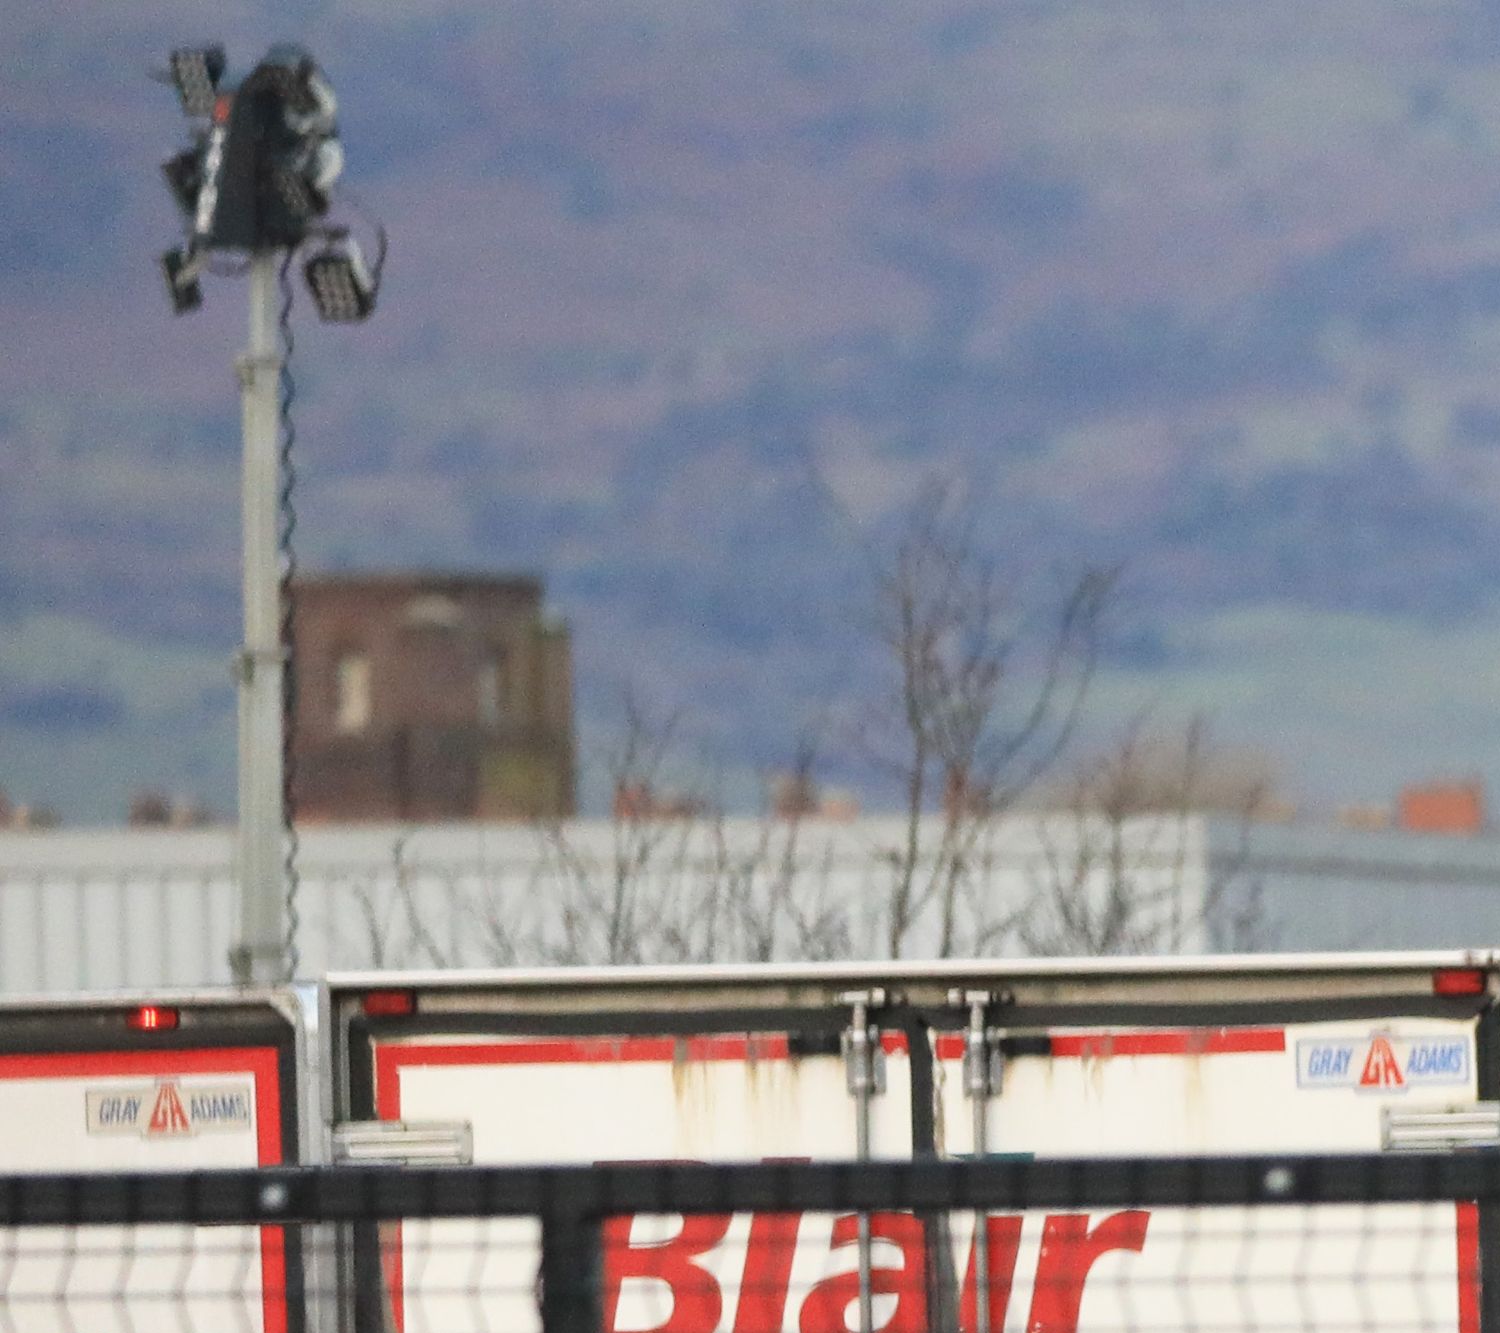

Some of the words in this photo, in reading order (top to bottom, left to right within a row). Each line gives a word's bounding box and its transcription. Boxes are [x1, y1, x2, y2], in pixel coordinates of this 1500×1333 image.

[1309, 1046, 1353, 1076] GRAY
[1407, 1044, 1463, 1073] ADAMS
[100, 1097, 142, 1124] GRAY
[191, 1094, 247, 1120] ADAMS
